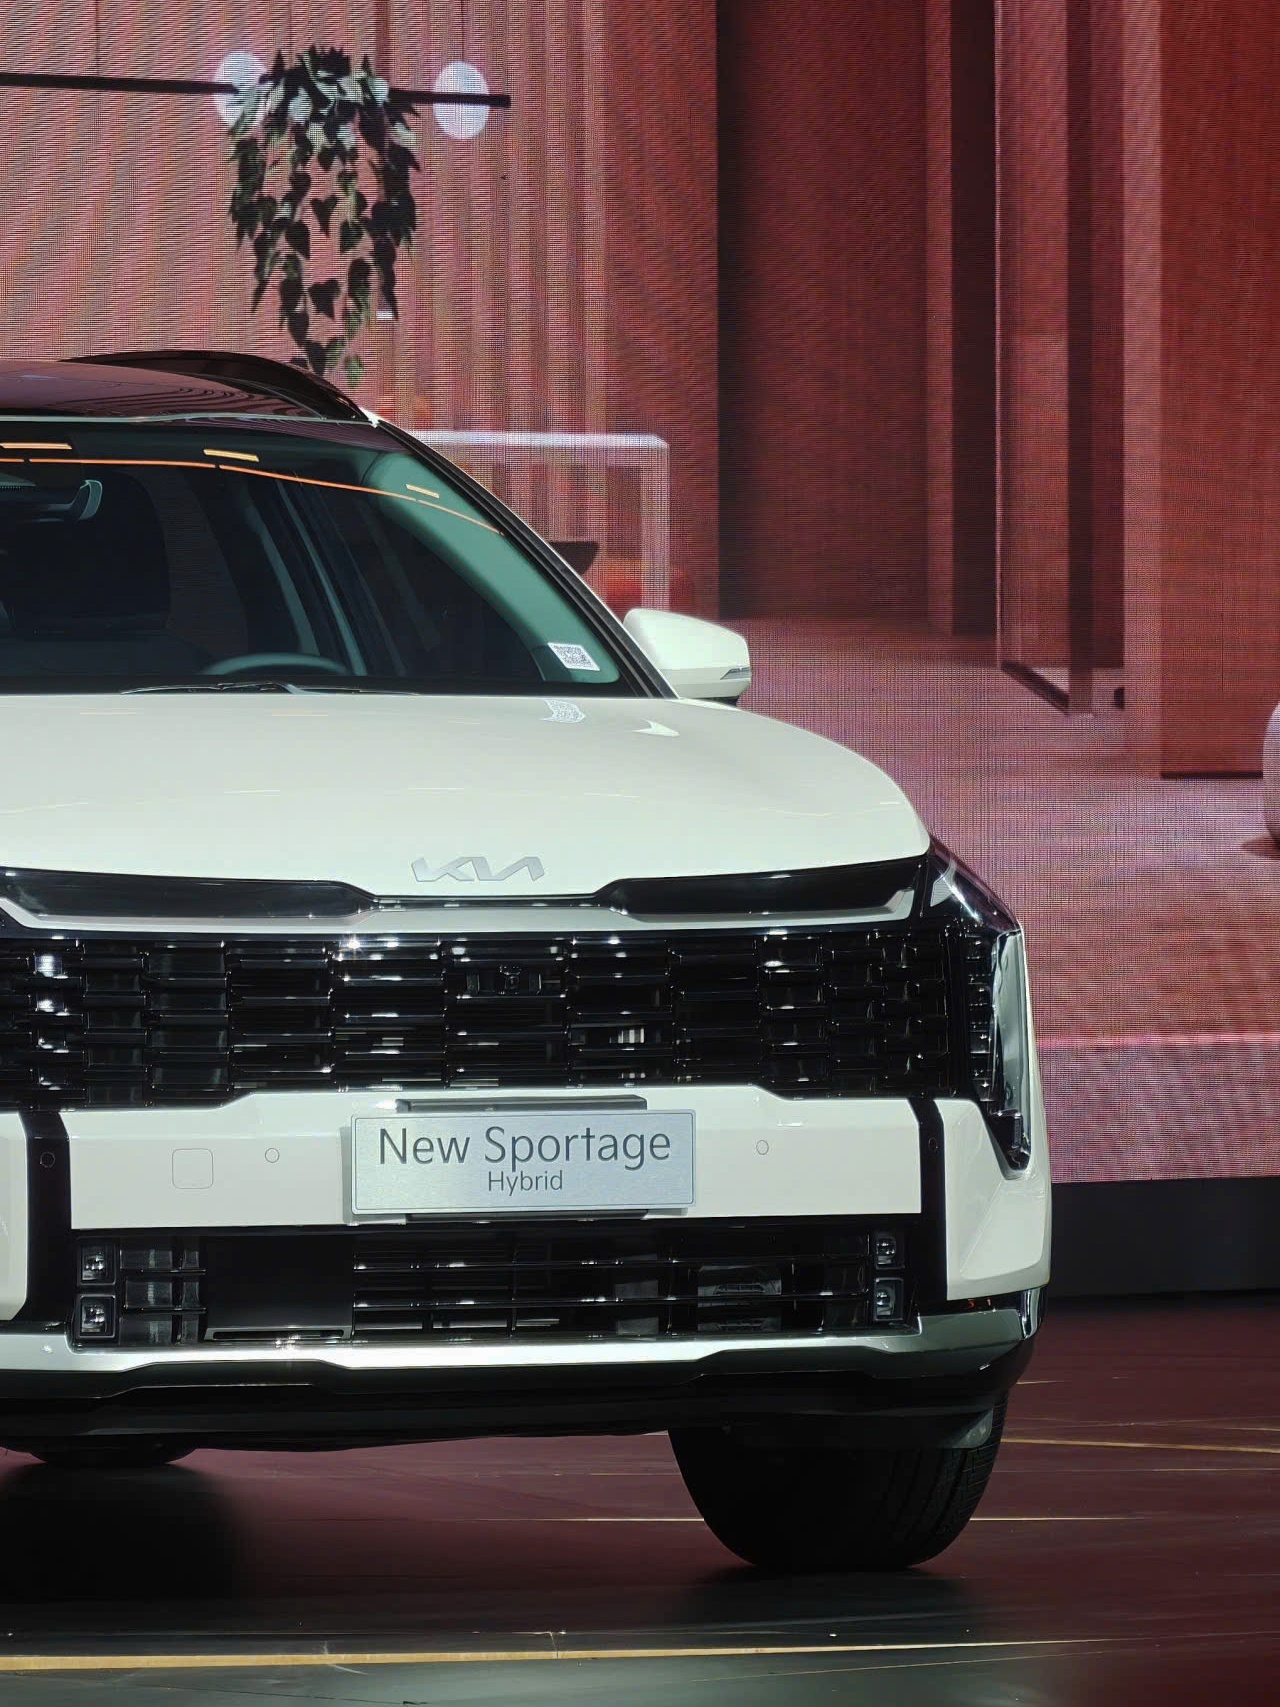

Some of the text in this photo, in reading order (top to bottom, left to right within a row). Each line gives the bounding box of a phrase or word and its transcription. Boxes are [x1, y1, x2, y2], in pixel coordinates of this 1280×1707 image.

[379, 1125, 671, 1173] New Sportage
[487, 1169, 564, 1196] Hybrid
